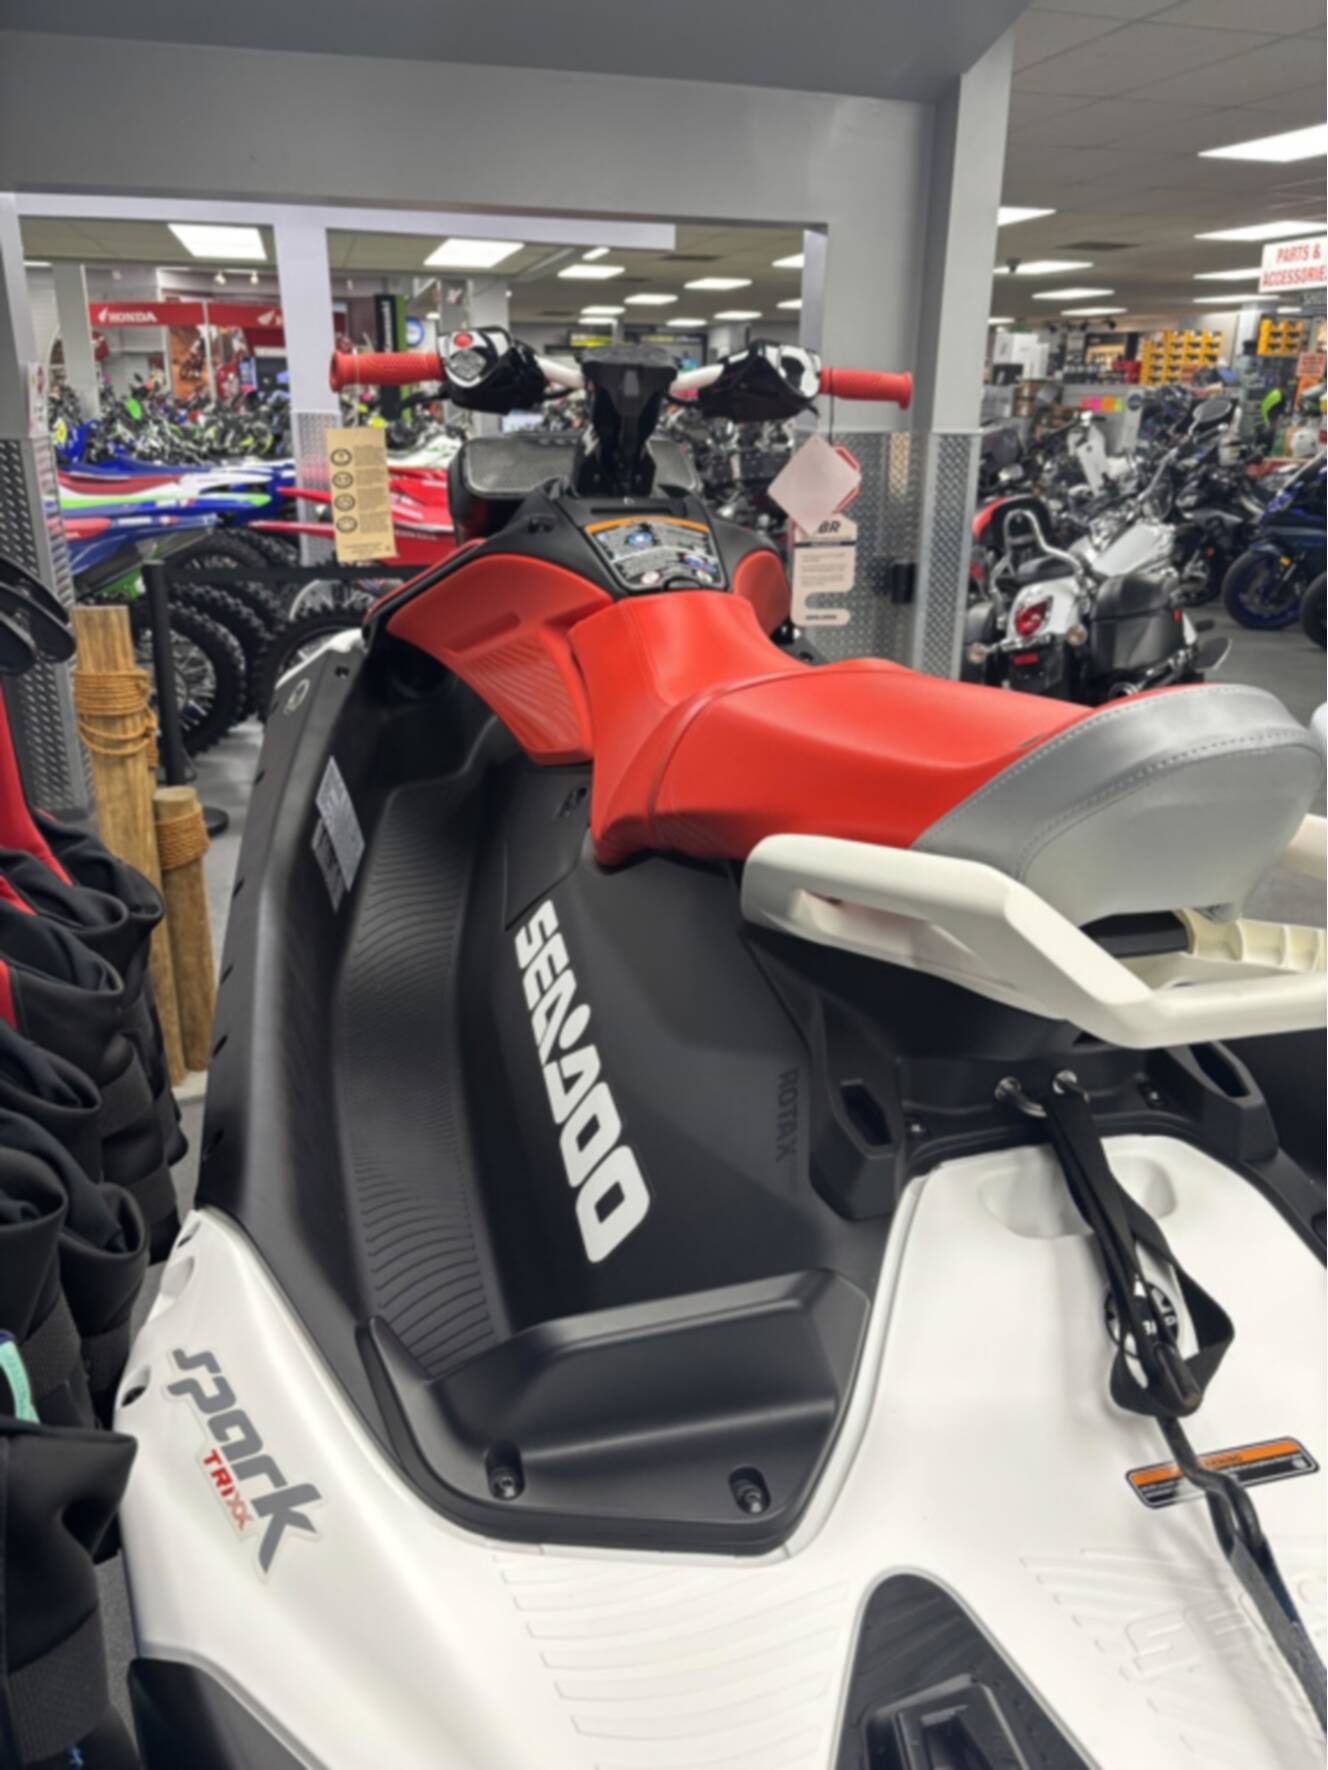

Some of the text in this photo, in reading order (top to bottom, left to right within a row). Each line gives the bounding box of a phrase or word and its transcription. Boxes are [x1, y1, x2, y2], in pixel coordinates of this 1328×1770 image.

[1276, 242, 1321, 262] PARTS &
[1262, 264, 1327, 287] ACCESSORIE
[108, 311, 157, 323] HONDA
[776, 1066, 799, 1163] ROTAX
